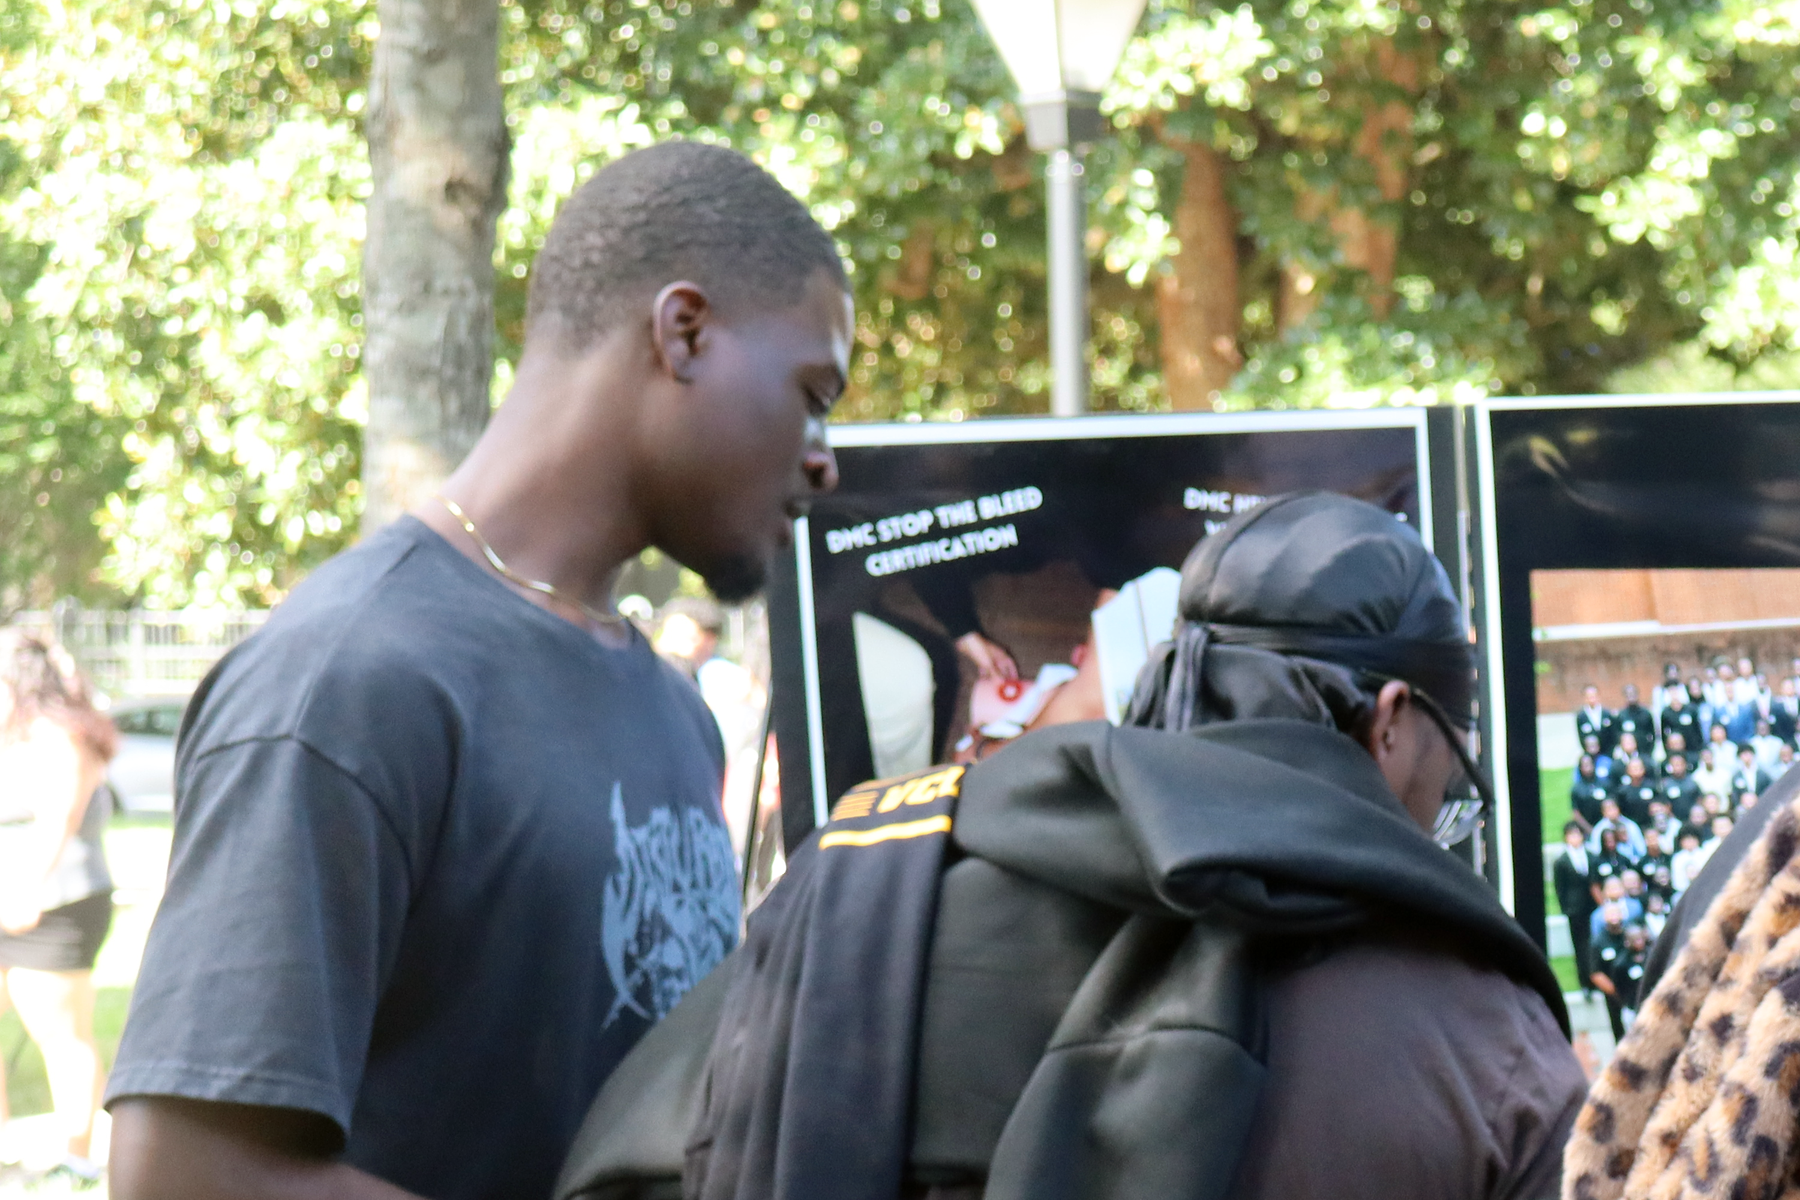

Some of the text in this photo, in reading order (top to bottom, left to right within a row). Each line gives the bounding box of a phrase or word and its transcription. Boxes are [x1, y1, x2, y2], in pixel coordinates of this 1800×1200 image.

[825, 486, 1044, 554] DMC STOP THE BLEED
[1183, 487, 1231, 513] DMC
[864, 523, 1019, 577] CERTIFICATION
